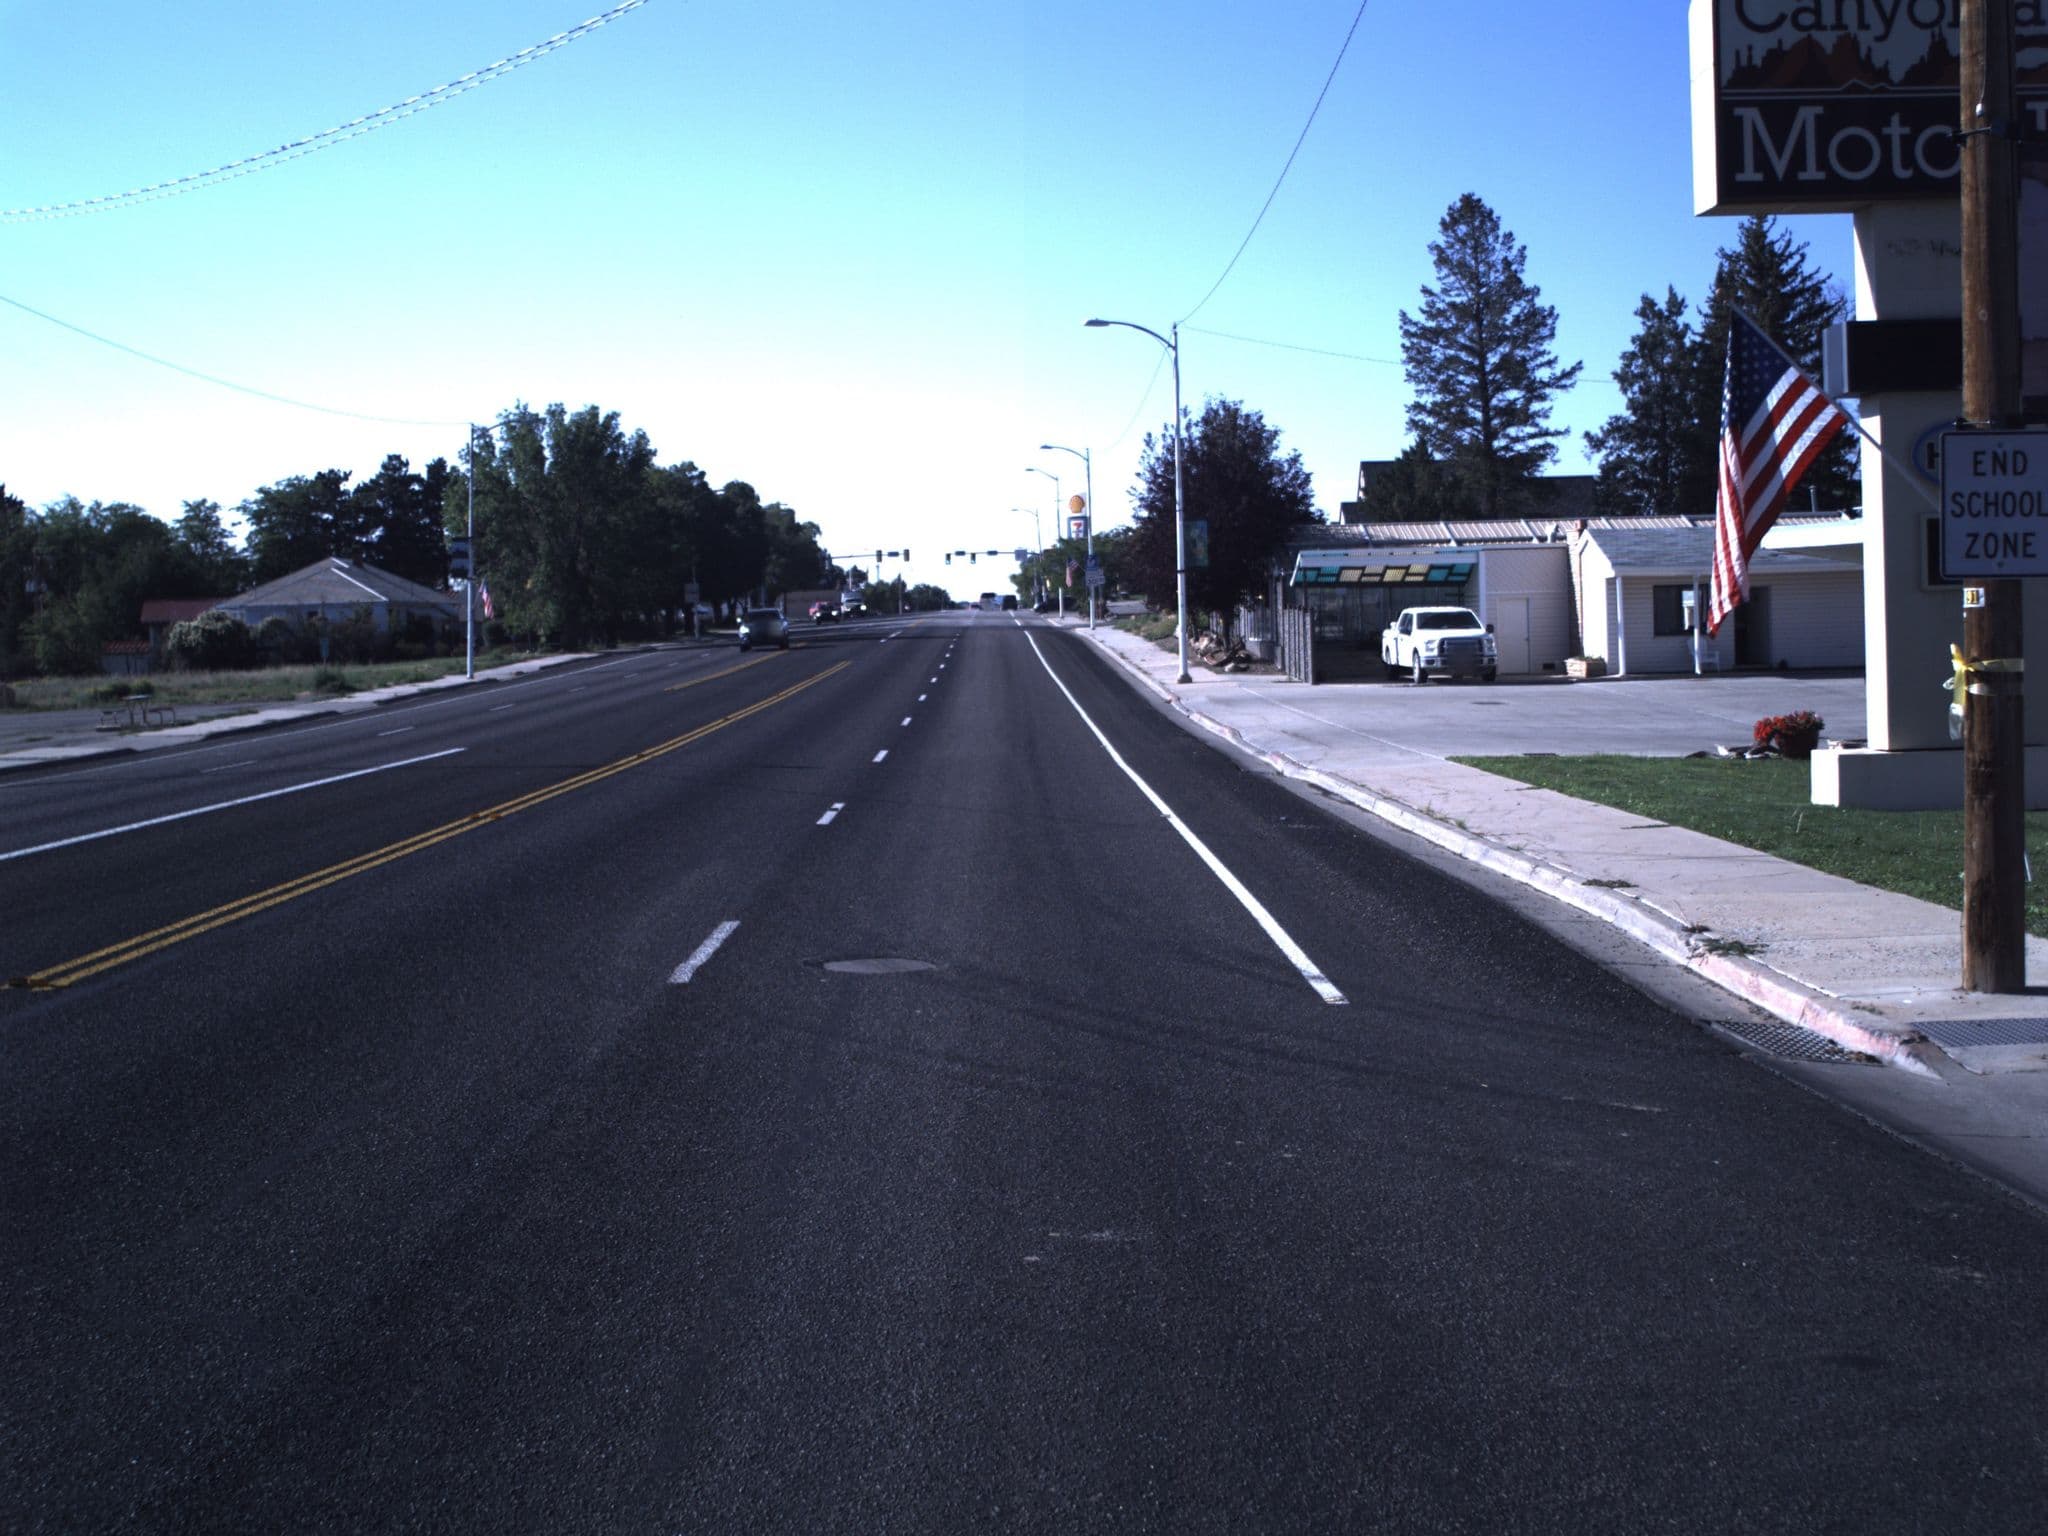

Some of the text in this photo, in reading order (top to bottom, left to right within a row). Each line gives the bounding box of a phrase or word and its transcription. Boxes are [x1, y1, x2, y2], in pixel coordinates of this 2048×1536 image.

[1735, 0, 1960, 42] Canyo
[1733, 105, 1960, 182] Moto
[1972, 450, 2028, 476] END
[1951, 490, 2048, 518] SCHOOL
[1964, 532, 2037, 559] ZONE
